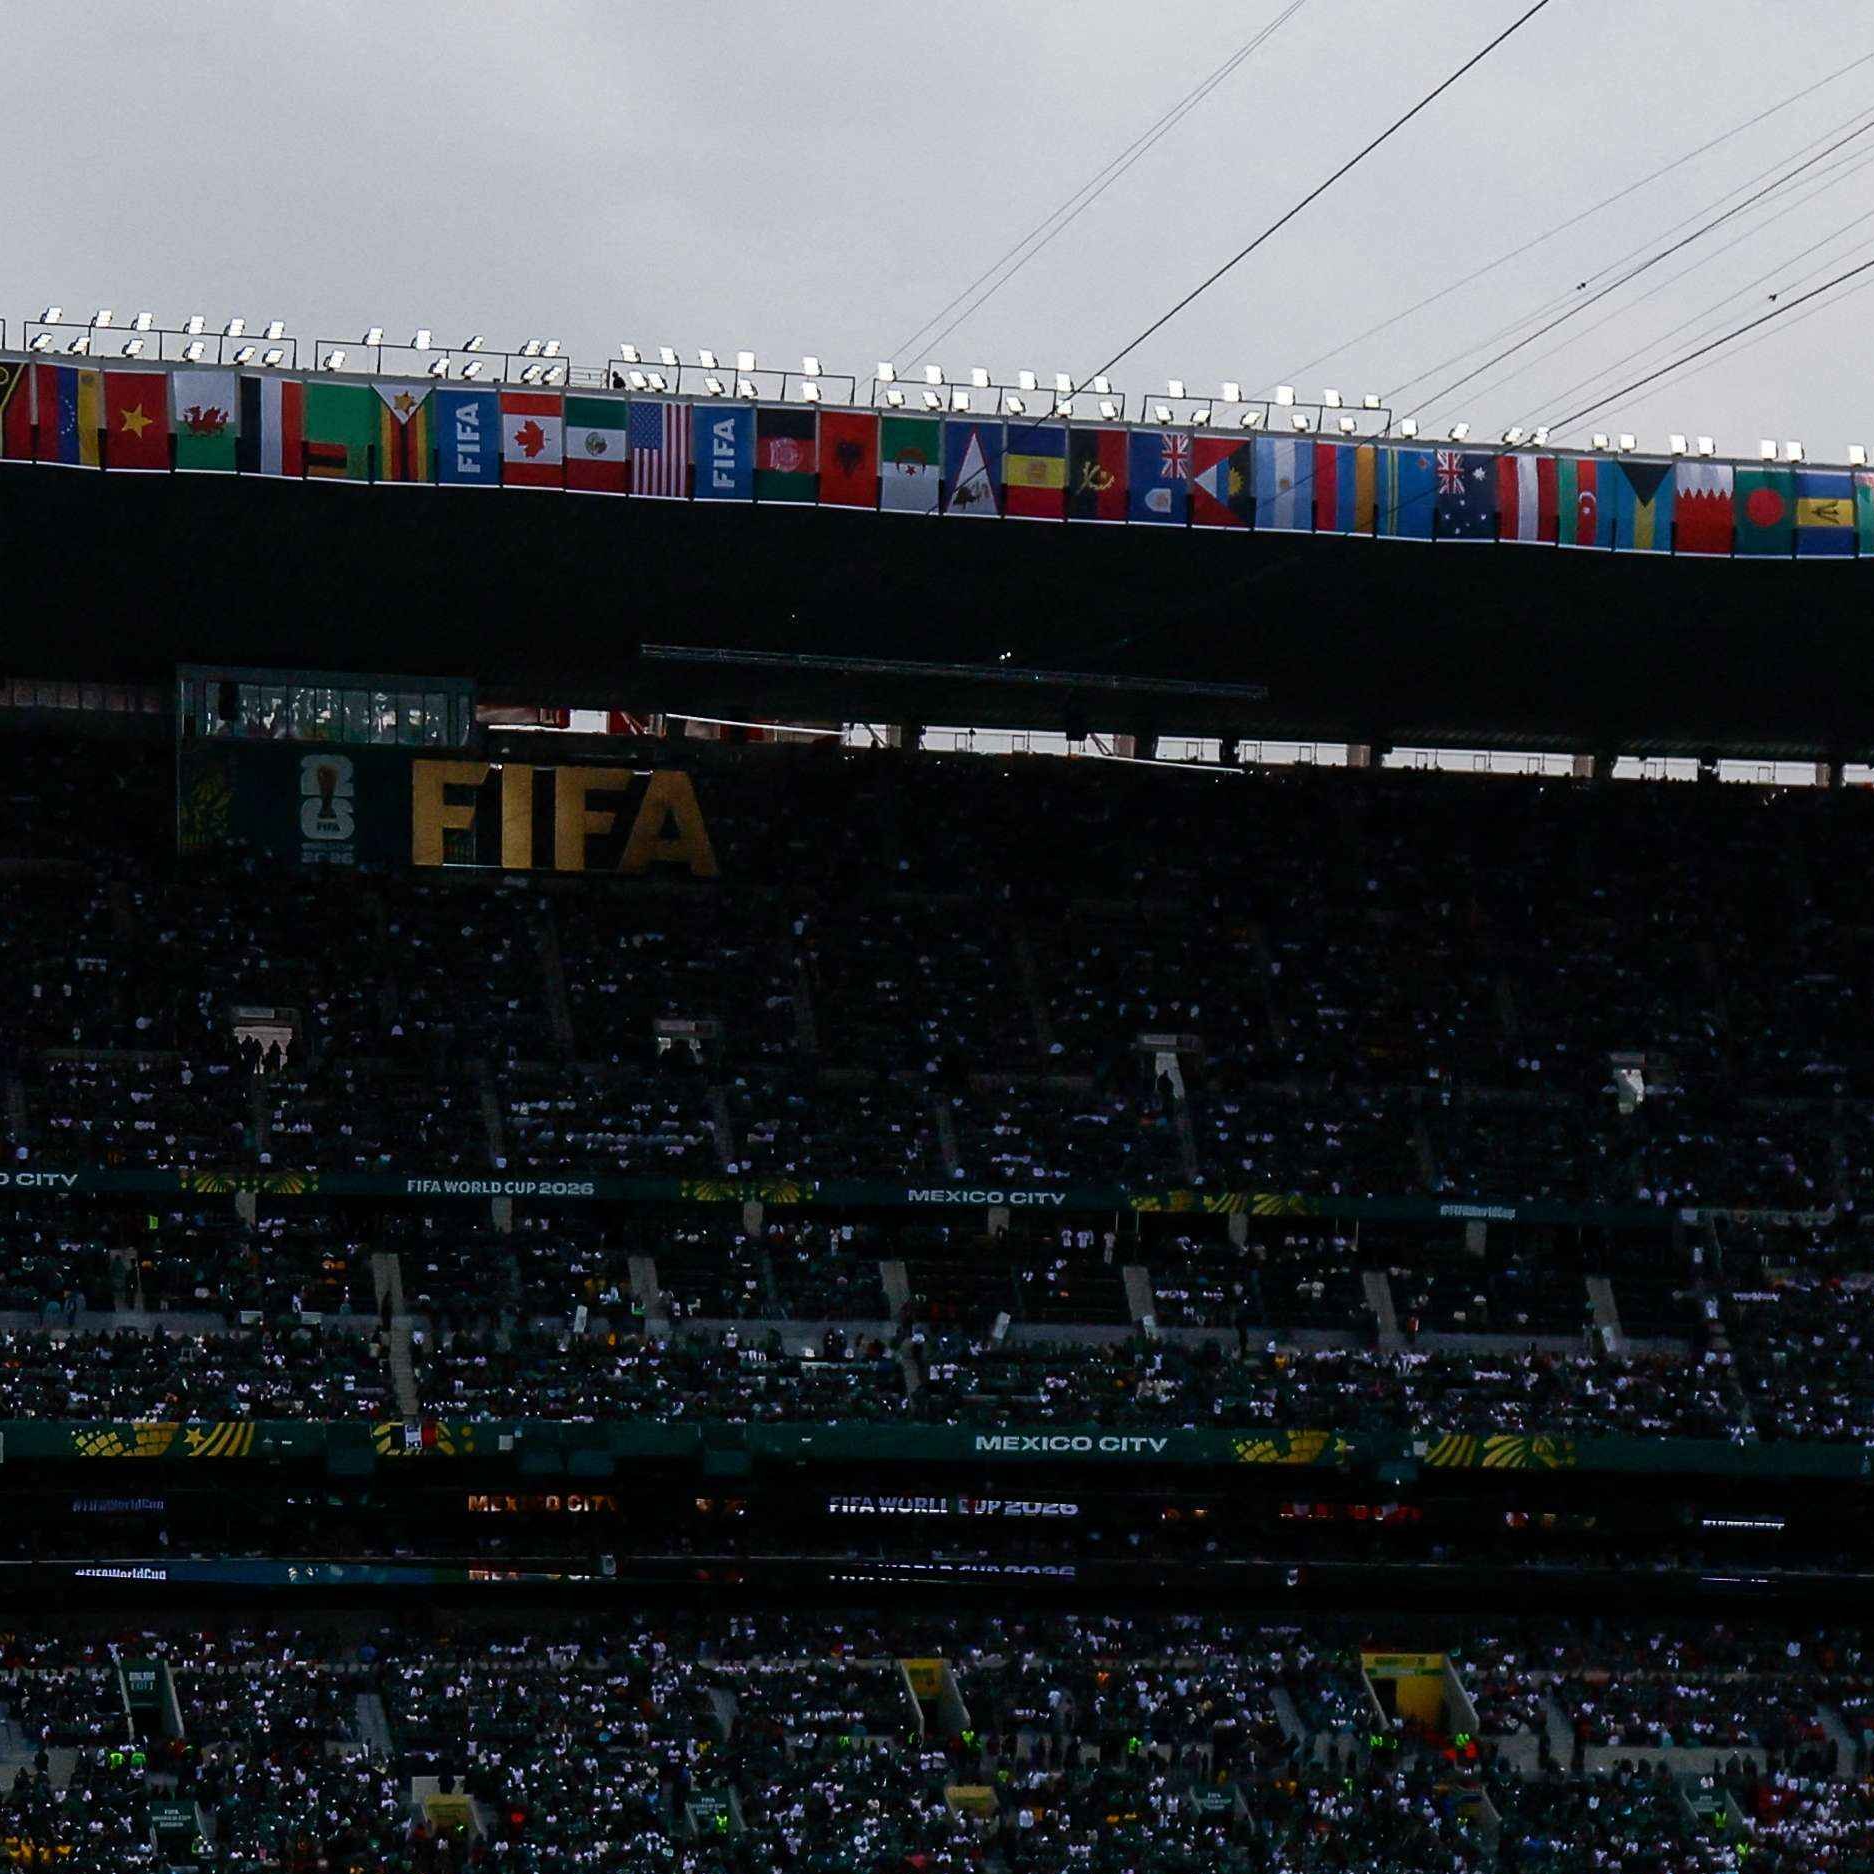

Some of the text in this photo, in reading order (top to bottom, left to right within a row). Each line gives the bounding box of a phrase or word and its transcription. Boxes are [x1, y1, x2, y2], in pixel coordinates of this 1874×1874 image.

[455, 401, 481, 474] FIFA
[712, 416, 736, 489] FIFA
[411, 757, 721, 877] FIFA
[15, 1172, 79, 1187] CITY
[407, 1179, 596, 1196] FIFA WORLD CUP 2026
[907, 1189, 1066, 1206] MEXICO CITY
[974, 1435, 1168, 1453] MEXICO CITY
[1003, 1501, 1079, 1518] 2026
